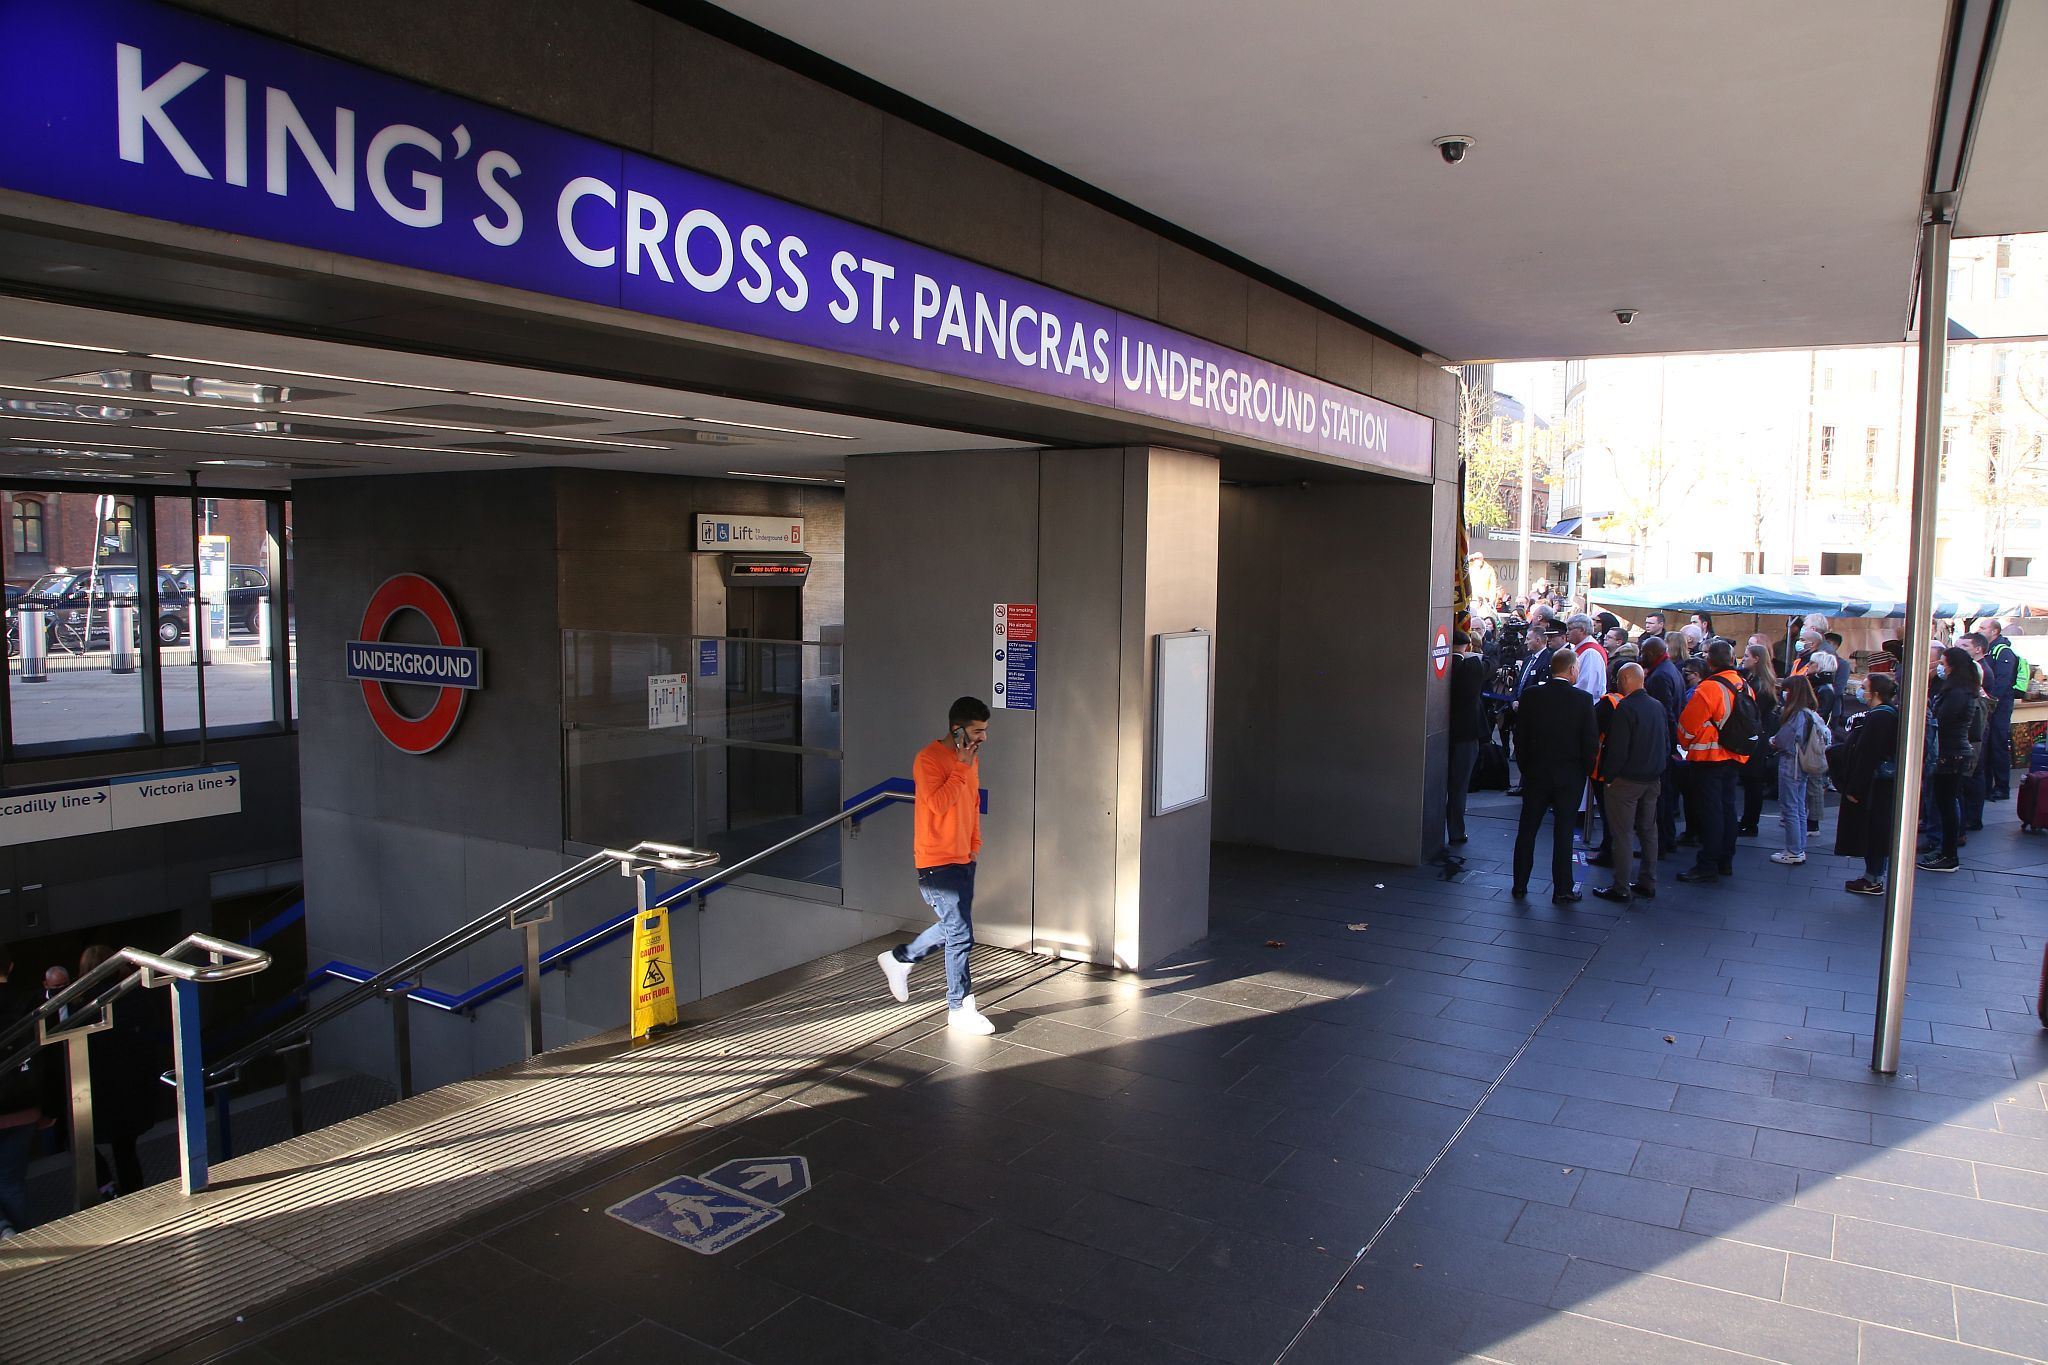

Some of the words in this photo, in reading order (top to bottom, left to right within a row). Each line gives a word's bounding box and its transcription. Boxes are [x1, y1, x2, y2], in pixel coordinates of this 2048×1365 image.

[116, 42, 524, 247] KING'S
[556, 176, 809, 313] CROSS
[827, 250, 900, 335] ST.
[913, 273, 1110, 384] PANCRAS
[1121, 336, 1316, 434] UNDERGROUND
[1320, 400, 1388, 453] STATION
[733, 526, 753, 540] Lift
[755, 534, 782, 542] Underground
[792, 532, 800, 541] D
[1710, 594, 1755, 606] MARKET
[352, 649, 472, 678] UNDERGROUND
[139, 781, 194, 798] Victoria
[198, 776, 223, 790] line
[62, 794, 91, 809] line
[640, 944, 664, 957] CAUTION
[640, 992, 652, 1003] WET
[653, 987, 669, 998] FLOOR
